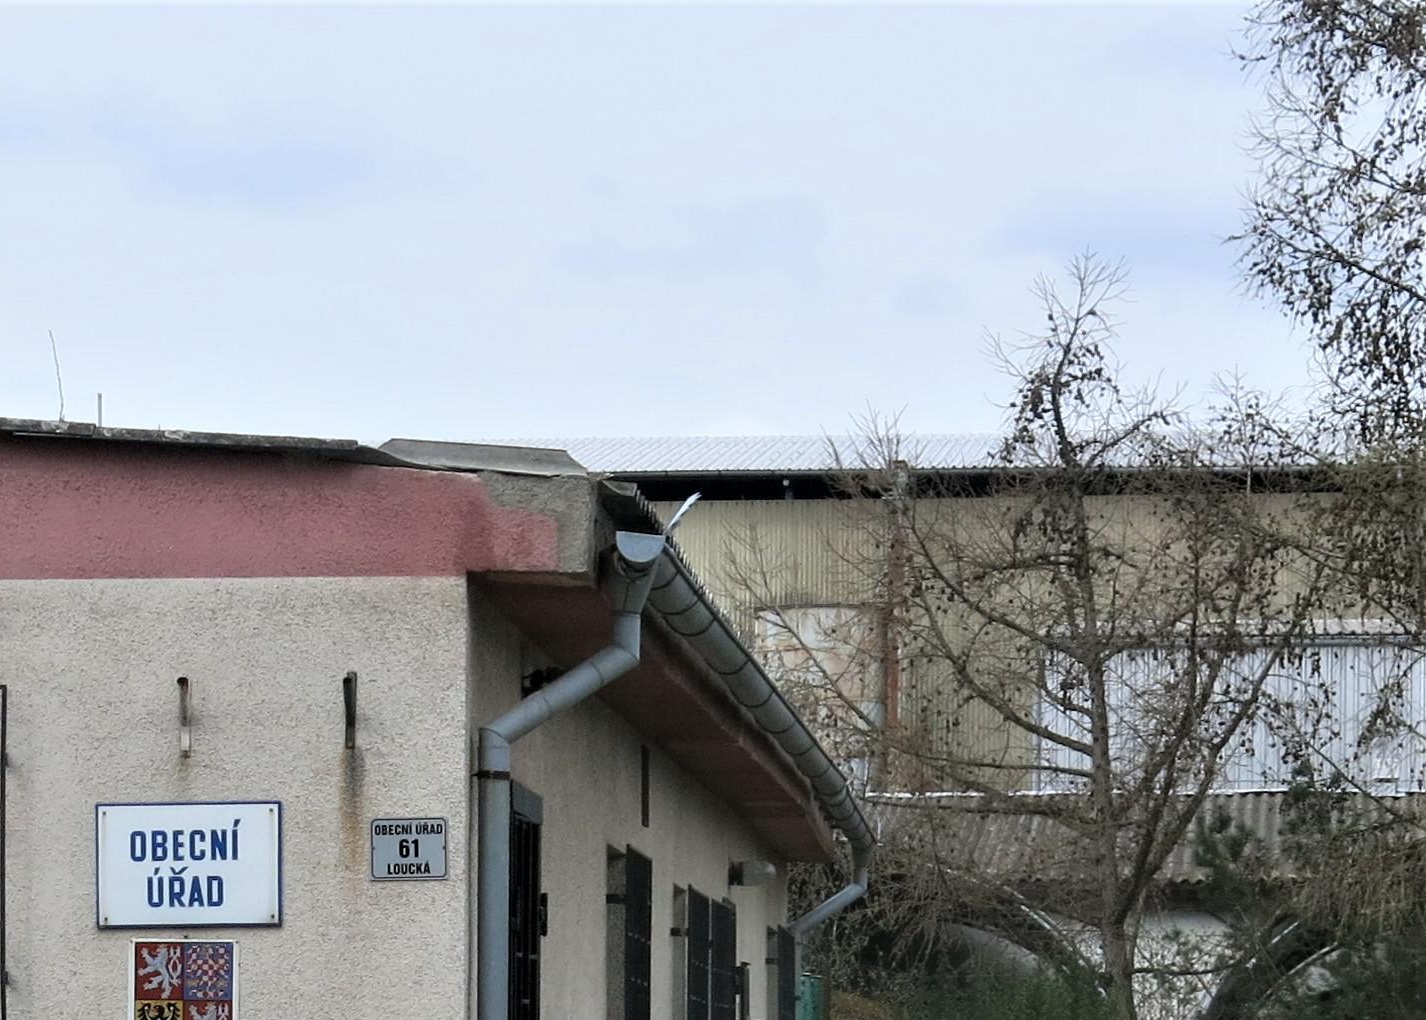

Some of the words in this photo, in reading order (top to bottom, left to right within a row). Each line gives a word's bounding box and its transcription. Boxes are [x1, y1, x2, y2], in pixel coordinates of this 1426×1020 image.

[374, 822, 413, 836] OBECNÍ
[415, 821, 443, 835] ÚŘAD
[130, 818, 241, 862] OBECNÍ
[398, 838, 419, 859] 61
[387, 860, 431, 875] LOUCKÁ
[147, 866, 224, 908] ÚŘAD
